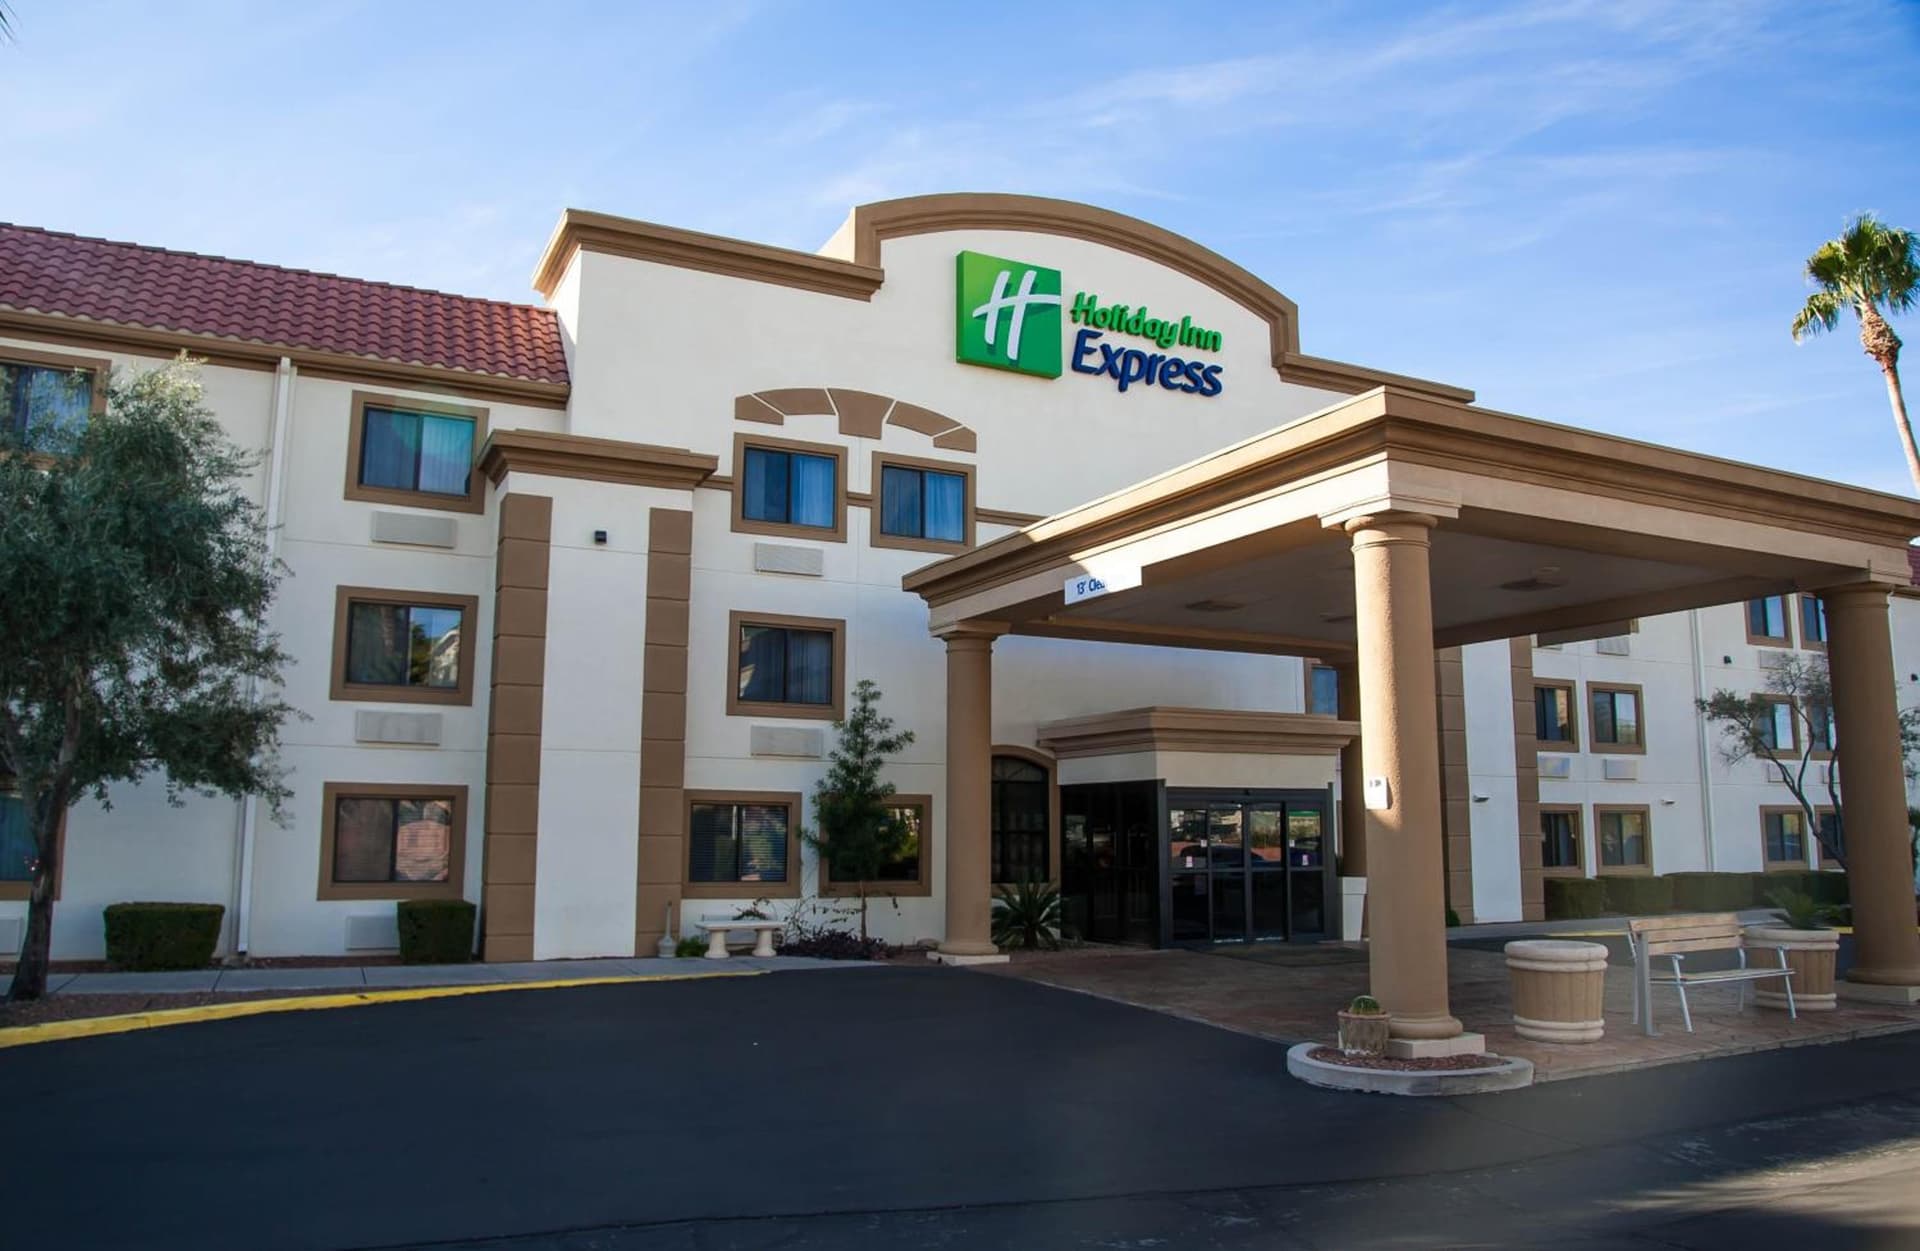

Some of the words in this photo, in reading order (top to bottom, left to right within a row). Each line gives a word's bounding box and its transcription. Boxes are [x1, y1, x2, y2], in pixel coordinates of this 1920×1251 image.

[1070, 292, 1179, 349] Holiday
[1180, 315, 1222, 352] Inn
[1071, 328, 1223, 397] Express
